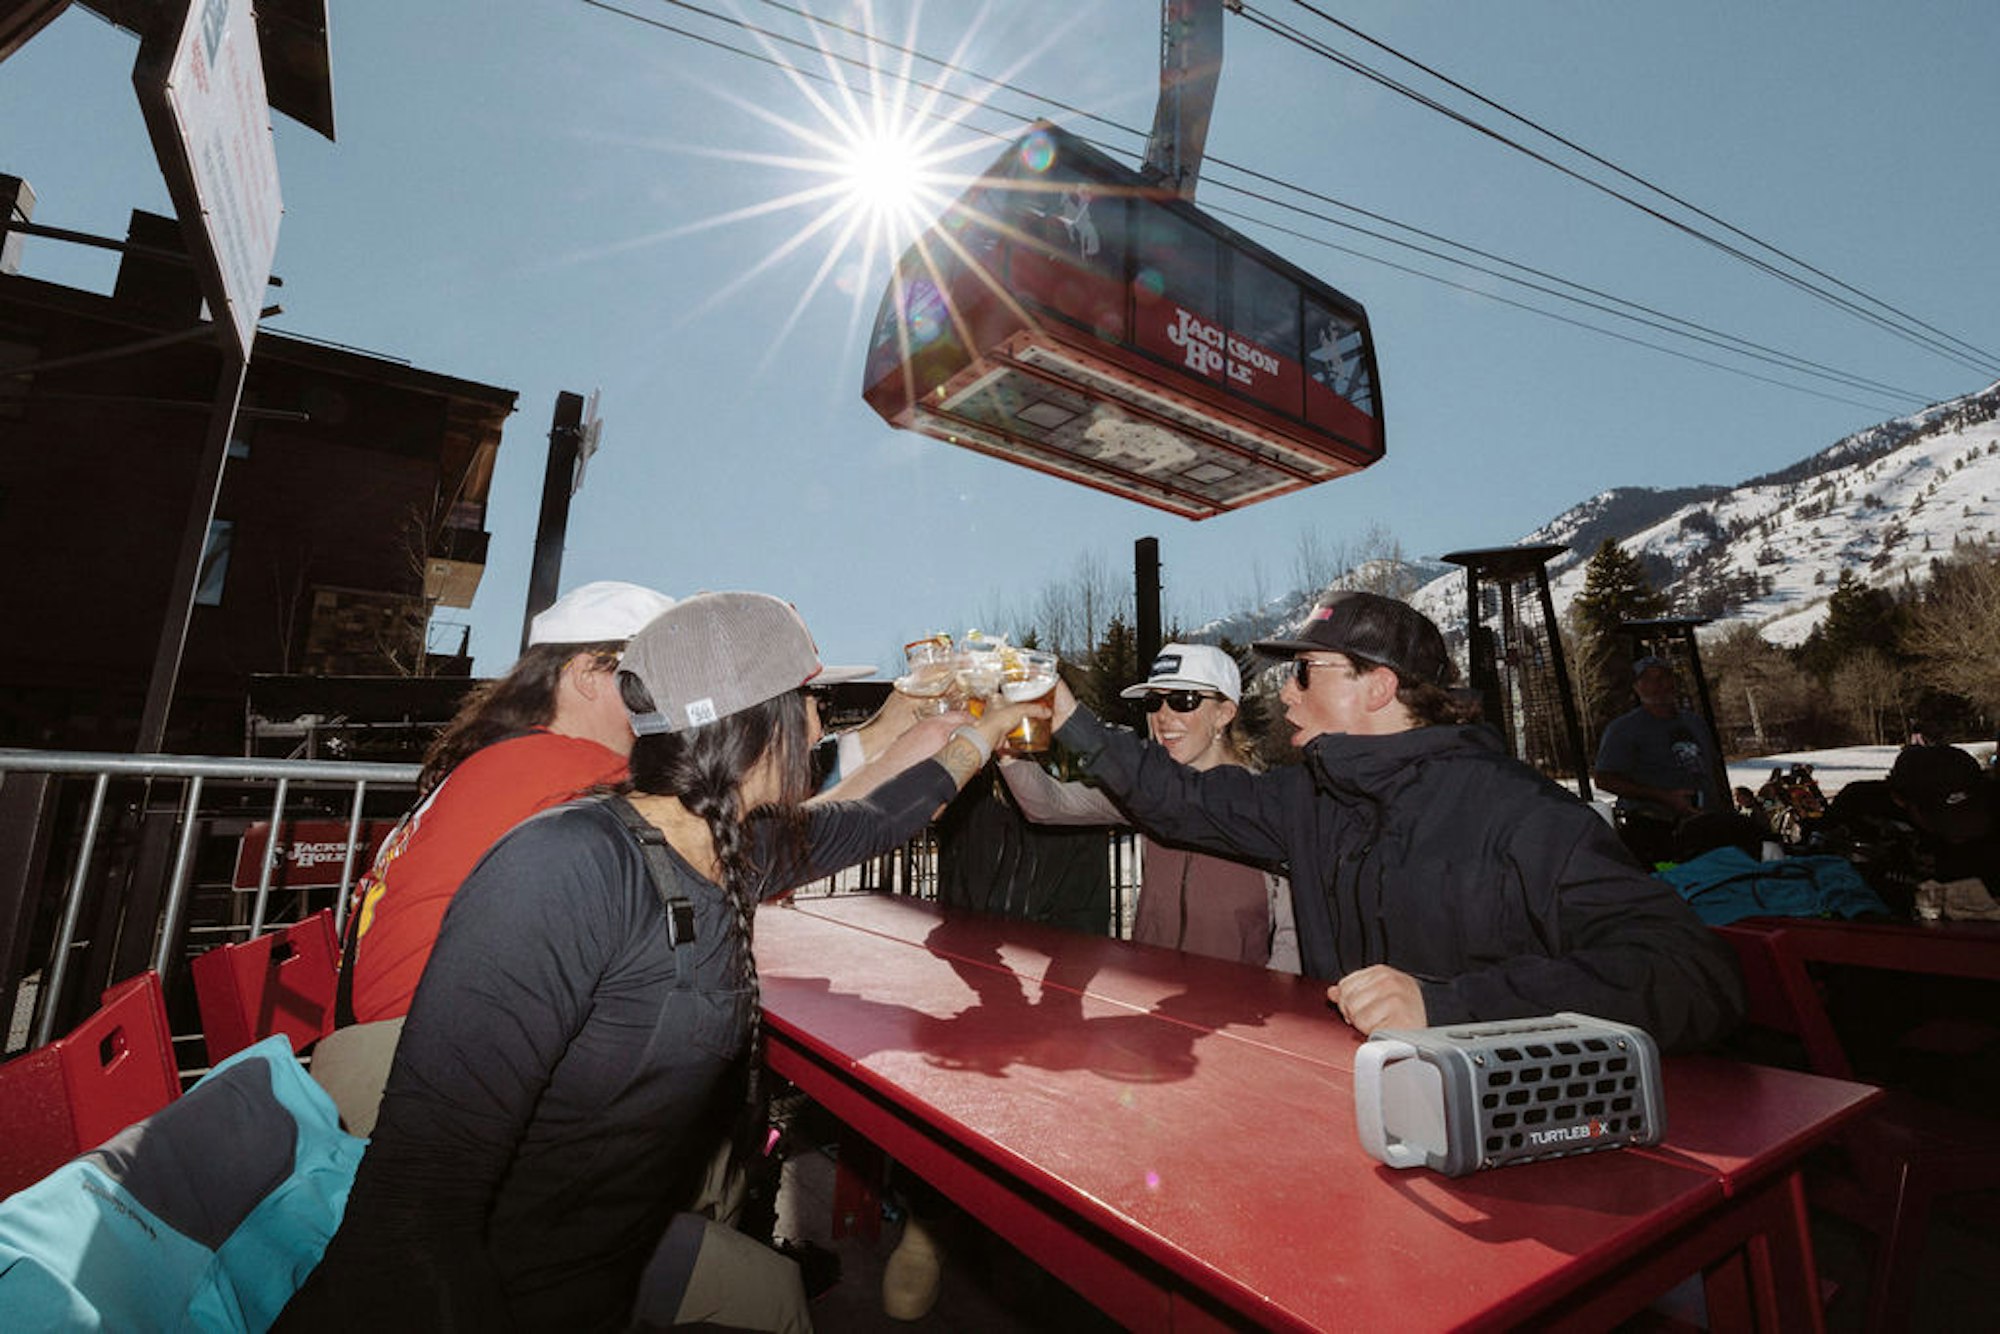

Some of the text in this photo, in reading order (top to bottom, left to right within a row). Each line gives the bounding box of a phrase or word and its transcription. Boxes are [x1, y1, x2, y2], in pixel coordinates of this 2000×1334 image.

[1167, 308, 1280, 376] JACKSON
[1184, 338, 1253, 385] HOLE
[296, 852, 346, 868] HOLE
[1530, 1118, 1608, 1145] TURTLEBOX
